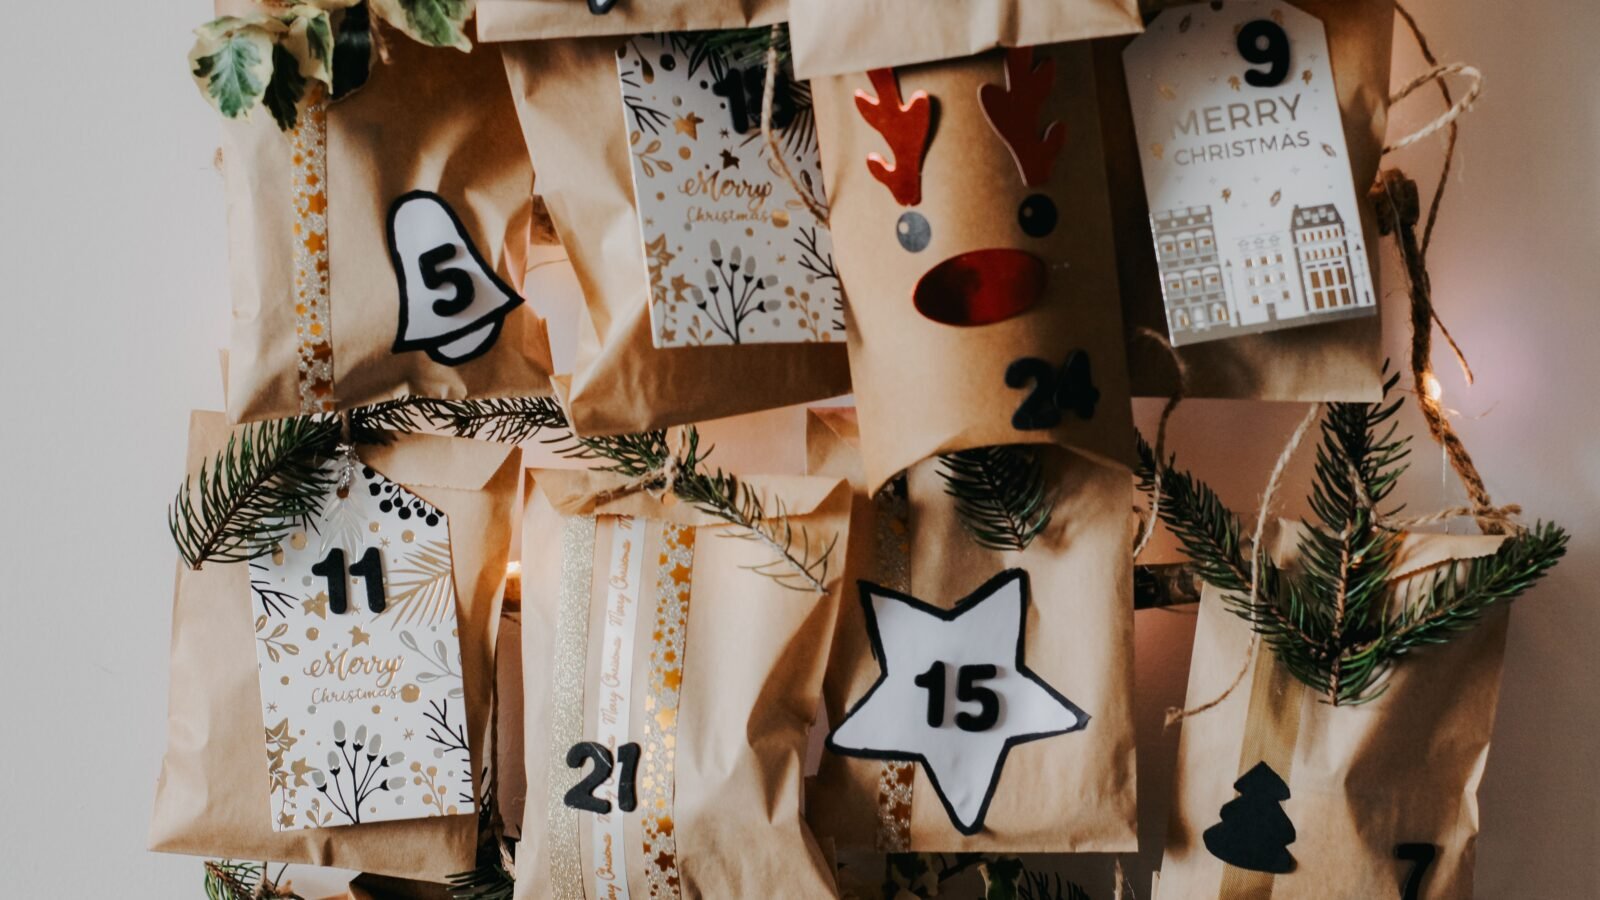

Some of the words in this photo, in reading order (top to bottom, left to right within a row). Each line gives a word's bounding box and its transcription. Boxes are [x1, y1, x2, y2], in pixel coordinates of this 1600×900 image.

[1237, 19, 1290, 88] 9
[1171, 94, 1301, 140] MERRY
[1174, 130, 1310, 166] CHRISTMAS
[677, 170, 772, 212] Merry
[687, 205, 769, 224] Christmas
[418, 243, 474, 317] 5
[1005, 348, 1099, 430] 24
[311, 547, 386, 615] 11
[303, 648, 405, 688] Merry
[311, 686, 401, 705] Christmas
[914, 660, 1000, 732] 15
[564, 741, 641, 815] 21
[1395, 842, 1435, 900] 7
